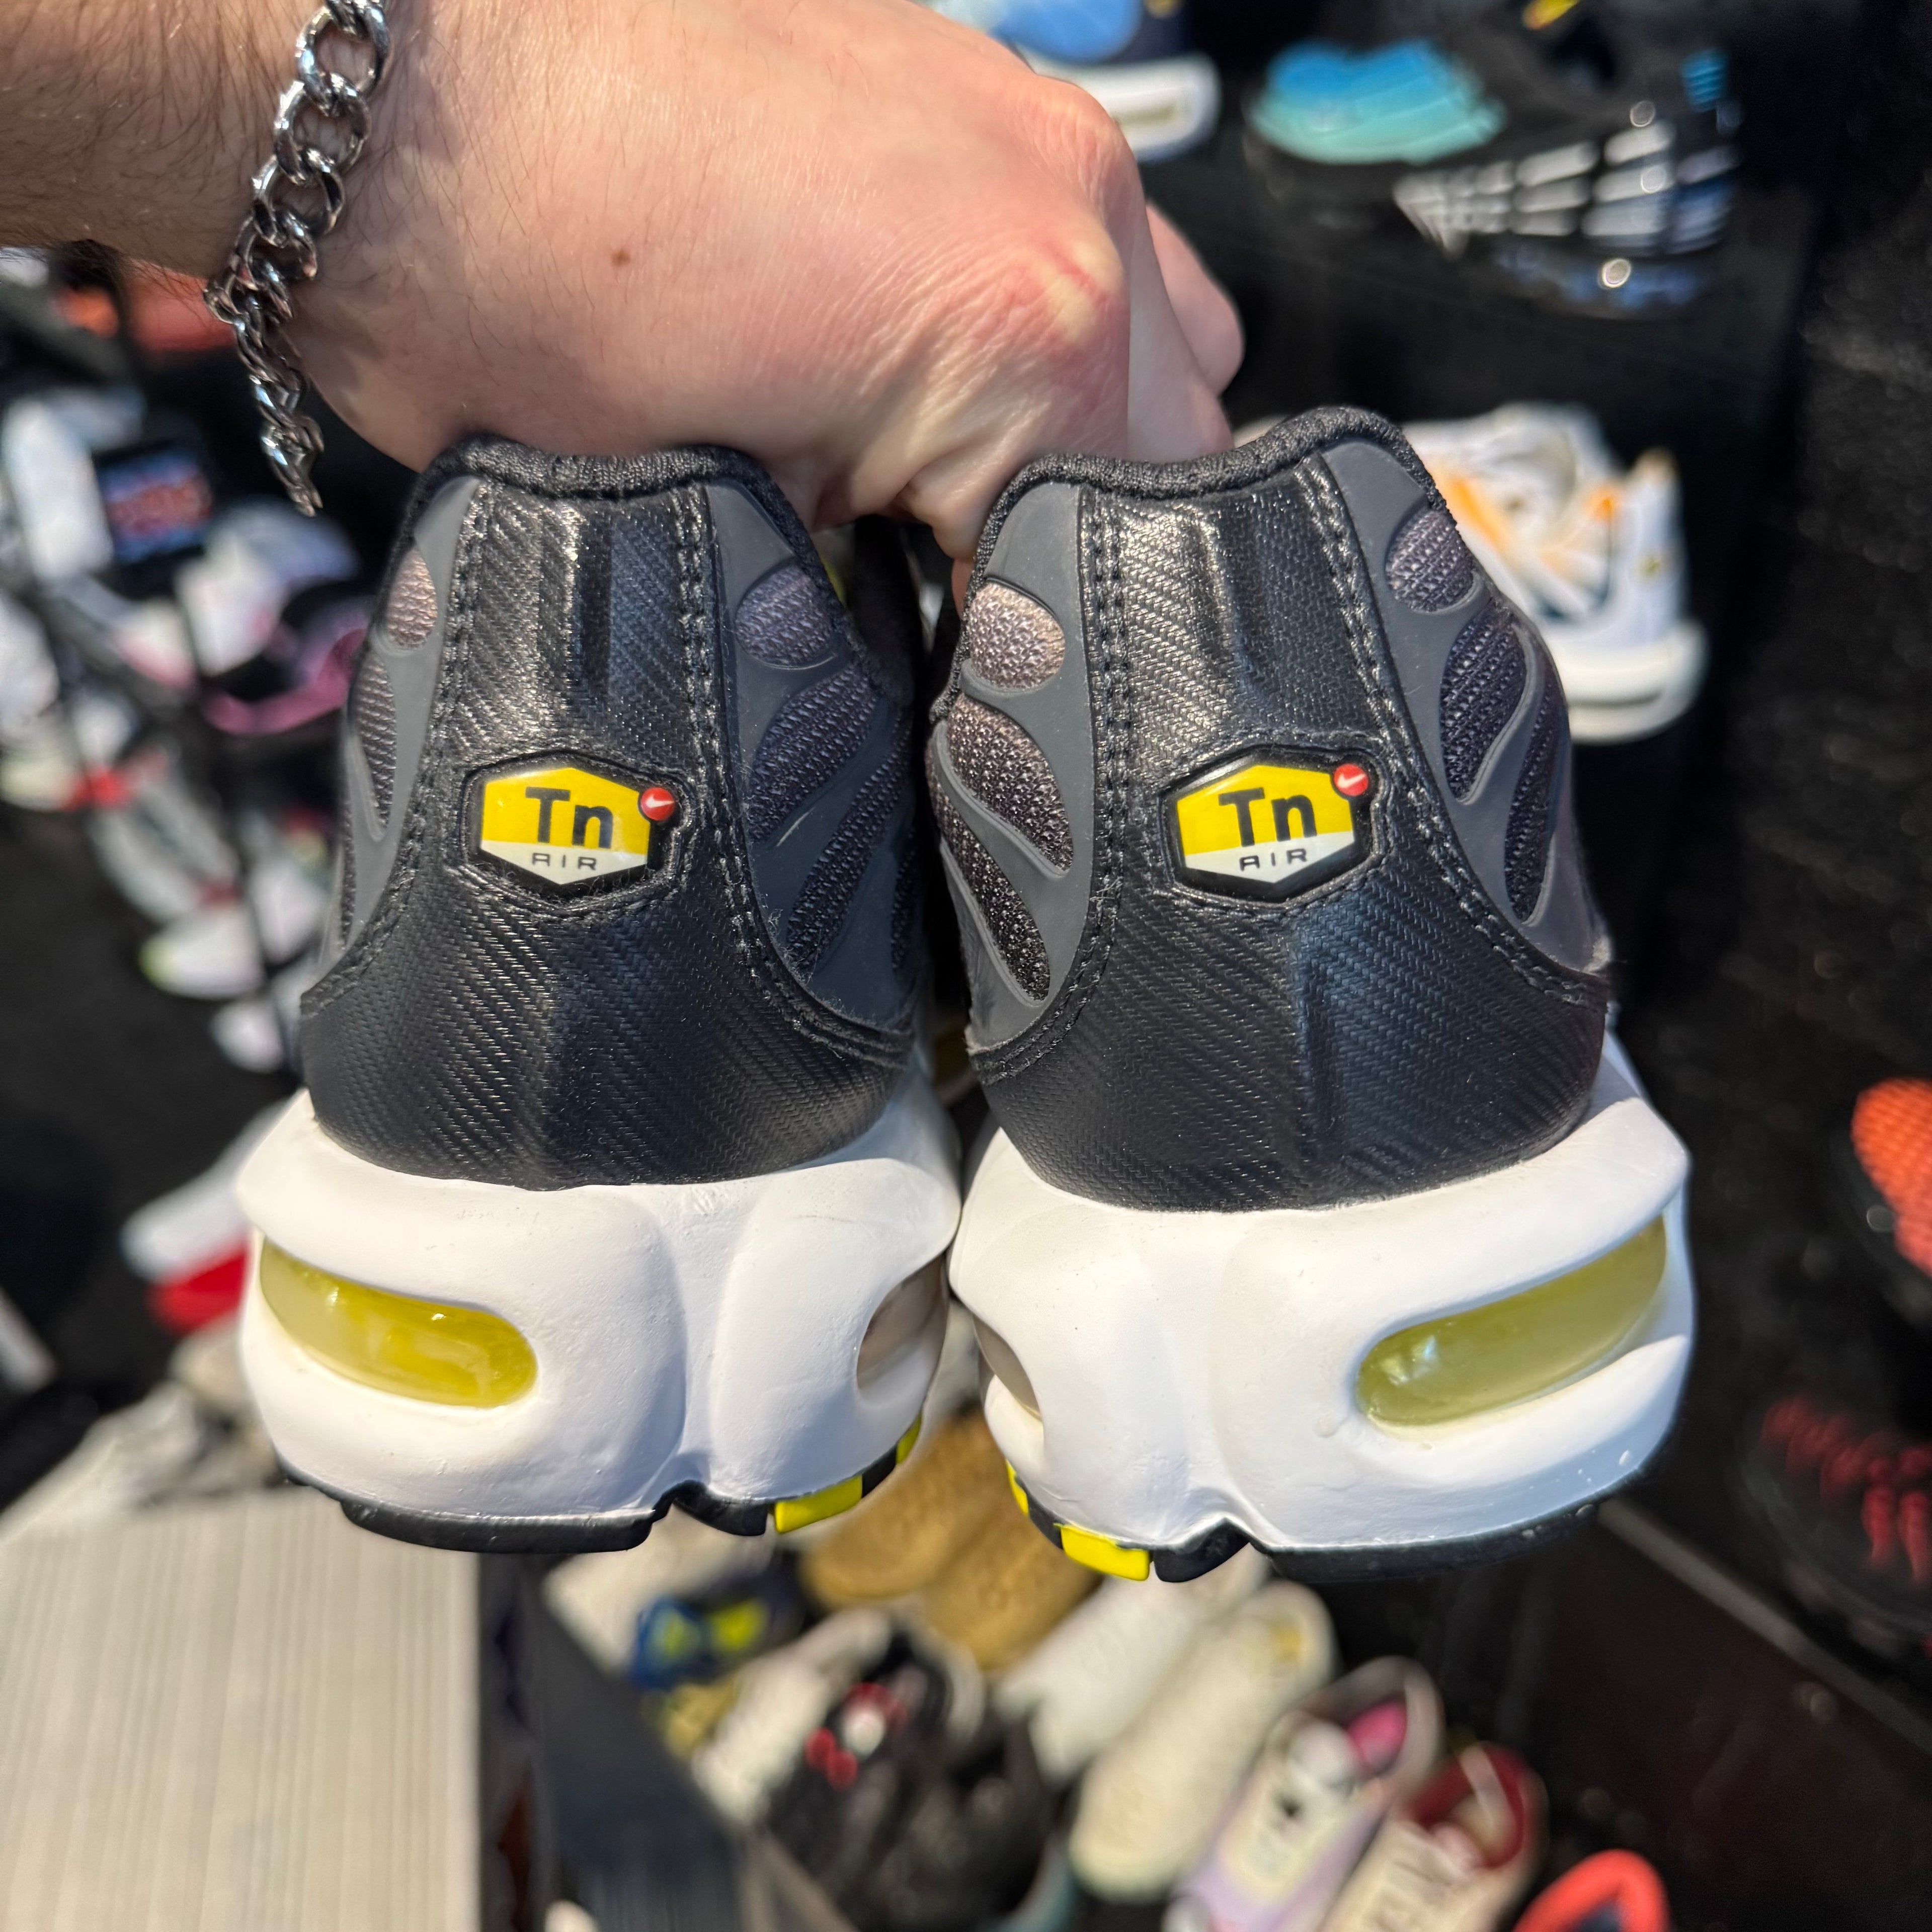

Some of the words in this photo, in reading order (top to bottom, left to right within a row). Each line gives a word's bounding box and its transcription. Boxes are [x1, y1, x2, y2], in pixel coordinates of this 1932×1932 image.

[525, 786, 614, 849] Tn
[1218, 787, 1317, 847] Tn
[532, 852, 597, 870] AIR
[1239, 848, 1308, 871] AIR
